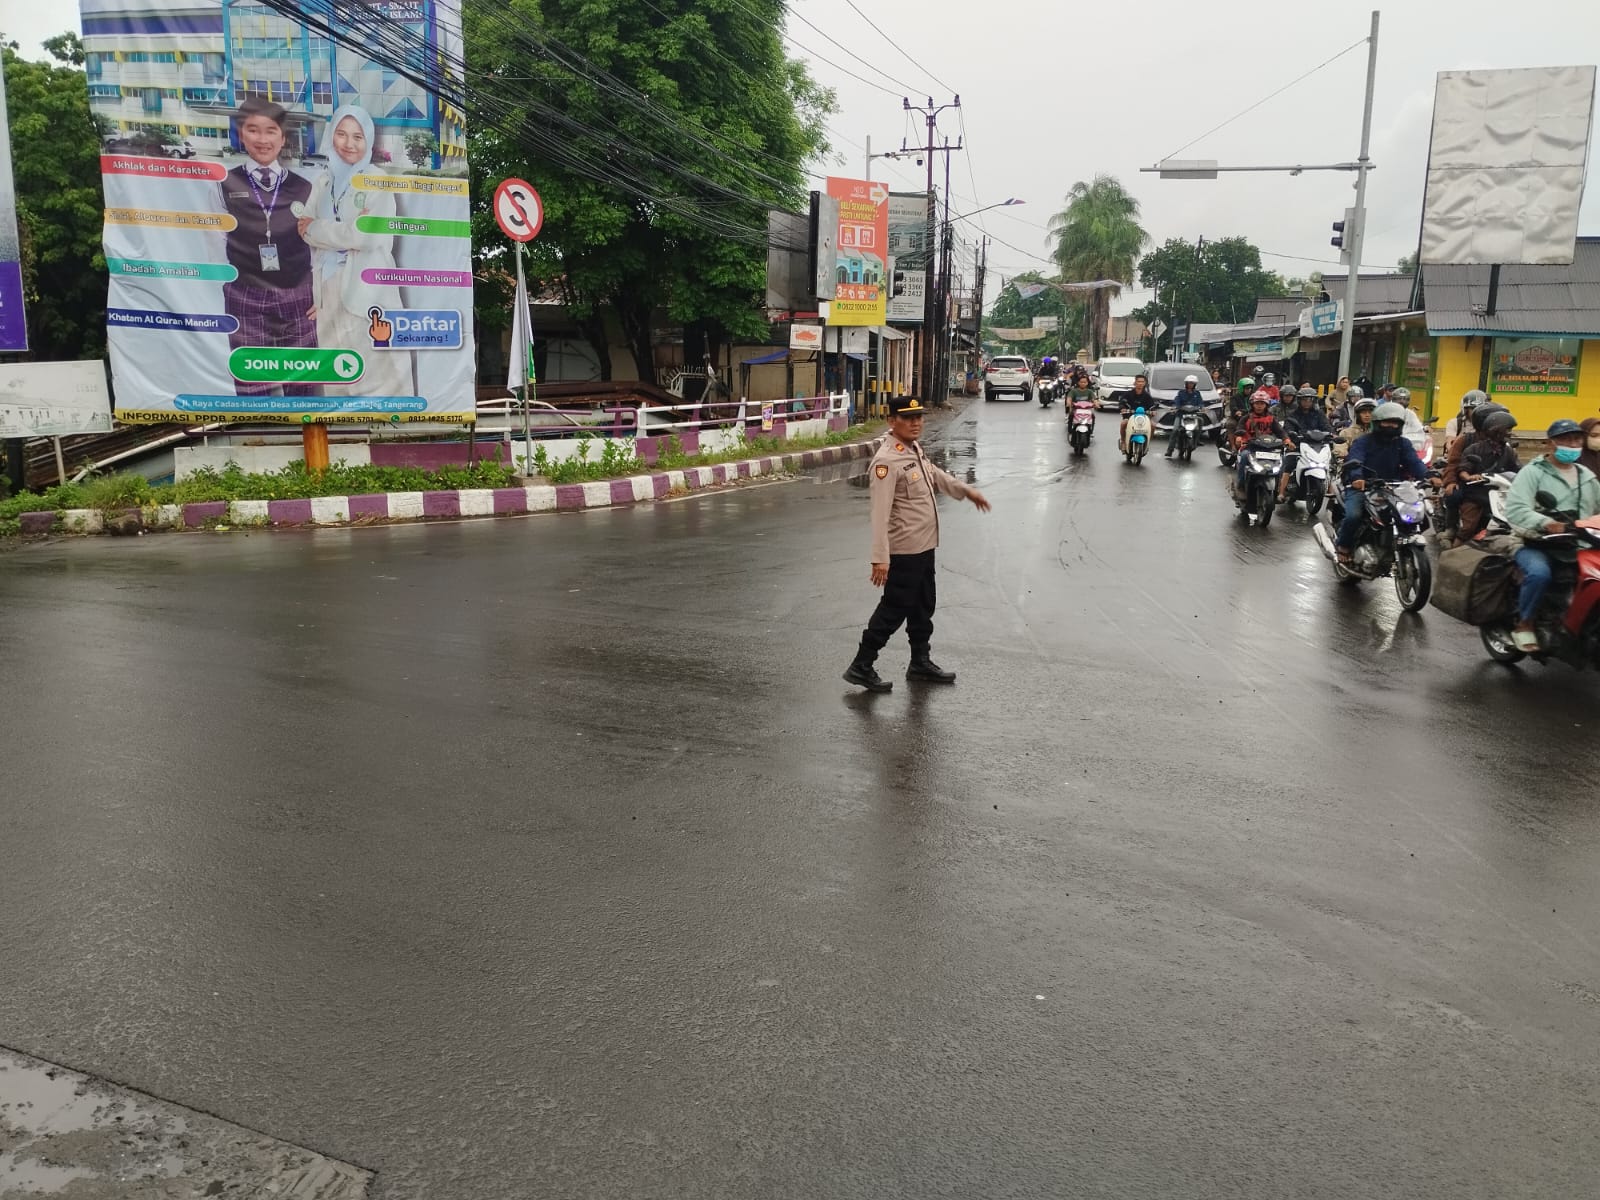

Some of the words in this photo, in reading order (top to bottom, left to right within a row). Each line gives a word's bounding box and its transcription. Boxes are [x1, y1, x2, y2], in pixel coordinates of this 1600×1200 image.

[112, 161, 145, 171] Akhlak
[148, 163, 166, 172] dan
[168, 164, 212, 175] Karakter
[363, 178, 409, 190] Perguruan
[410, 180, 434, 192] Tinggi
[388, 221, 428, 232] Bilingual
[122, 263, 156, 273] Ibadah
[158, 265, 200, 276] Amaliah
[375, 272, 422, 282] Kurikulum
[423, 275, 462, 283] Nasional
[108, 312, 143, 323] Khatam
[144, 315, 154, 324] Al
[155, 315, 183, 326] Quran
[184, 317, 219, 328] Mandiri
[395, 316, 457, 332] Daftar
[396, 334, 443, 344] Sekarang
[244, 359, 280, 370] JOIN
[283, 360, 321, 371] NOW
[1496, 384, 1526, 392] BUKA
[192, 400, 213, 410] Raya
[270, 401, 290, 409] Desa
[383, 401, 424, 411] Tangerang
[123, 412, 190, 422] INFORMASI
[195, 414, 226, 422] PPDB
[231, 414, 290, 423] 2025/2026
